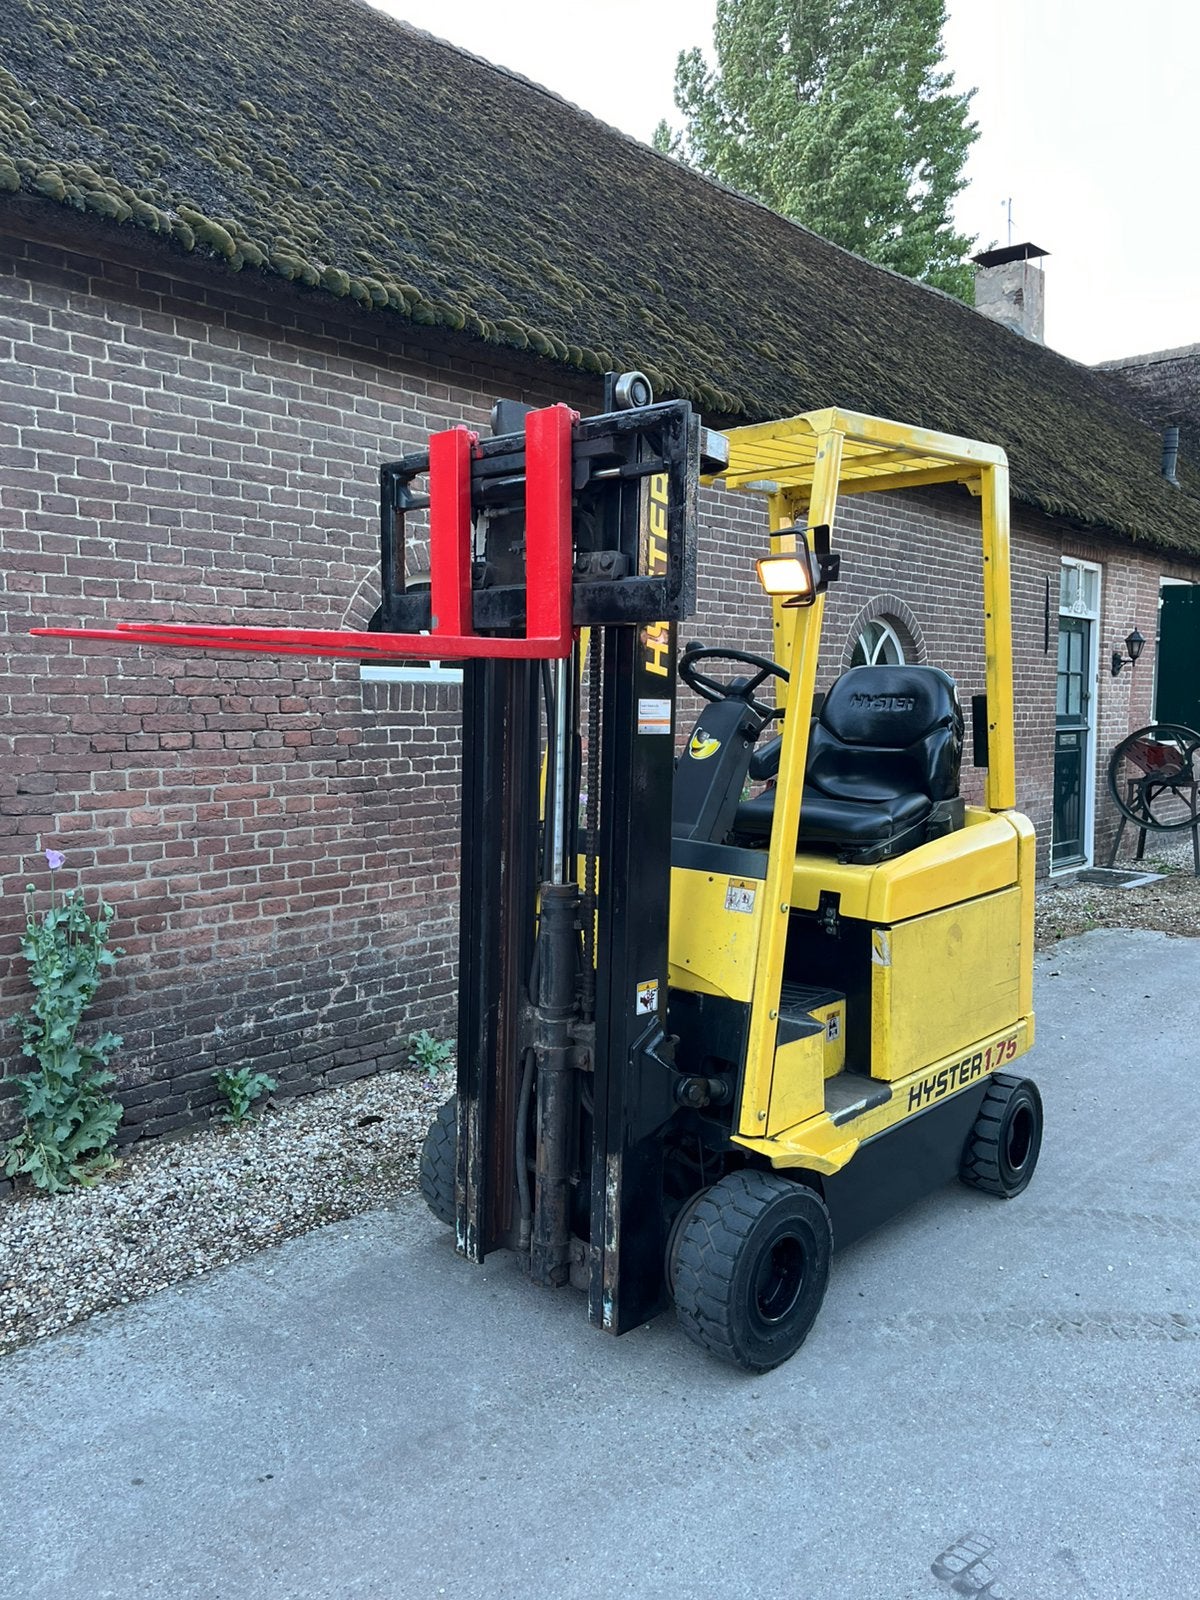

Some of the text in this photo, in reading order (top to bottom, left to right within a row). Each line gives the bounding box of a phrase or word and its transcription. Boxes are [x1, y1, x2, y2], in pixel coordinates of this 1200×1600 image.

[646, 473, 669, 677] HYTER
[850, 693, 915, 712] HYSTER
[908, 1034, 1018, 1112] HYSTER 1.75
